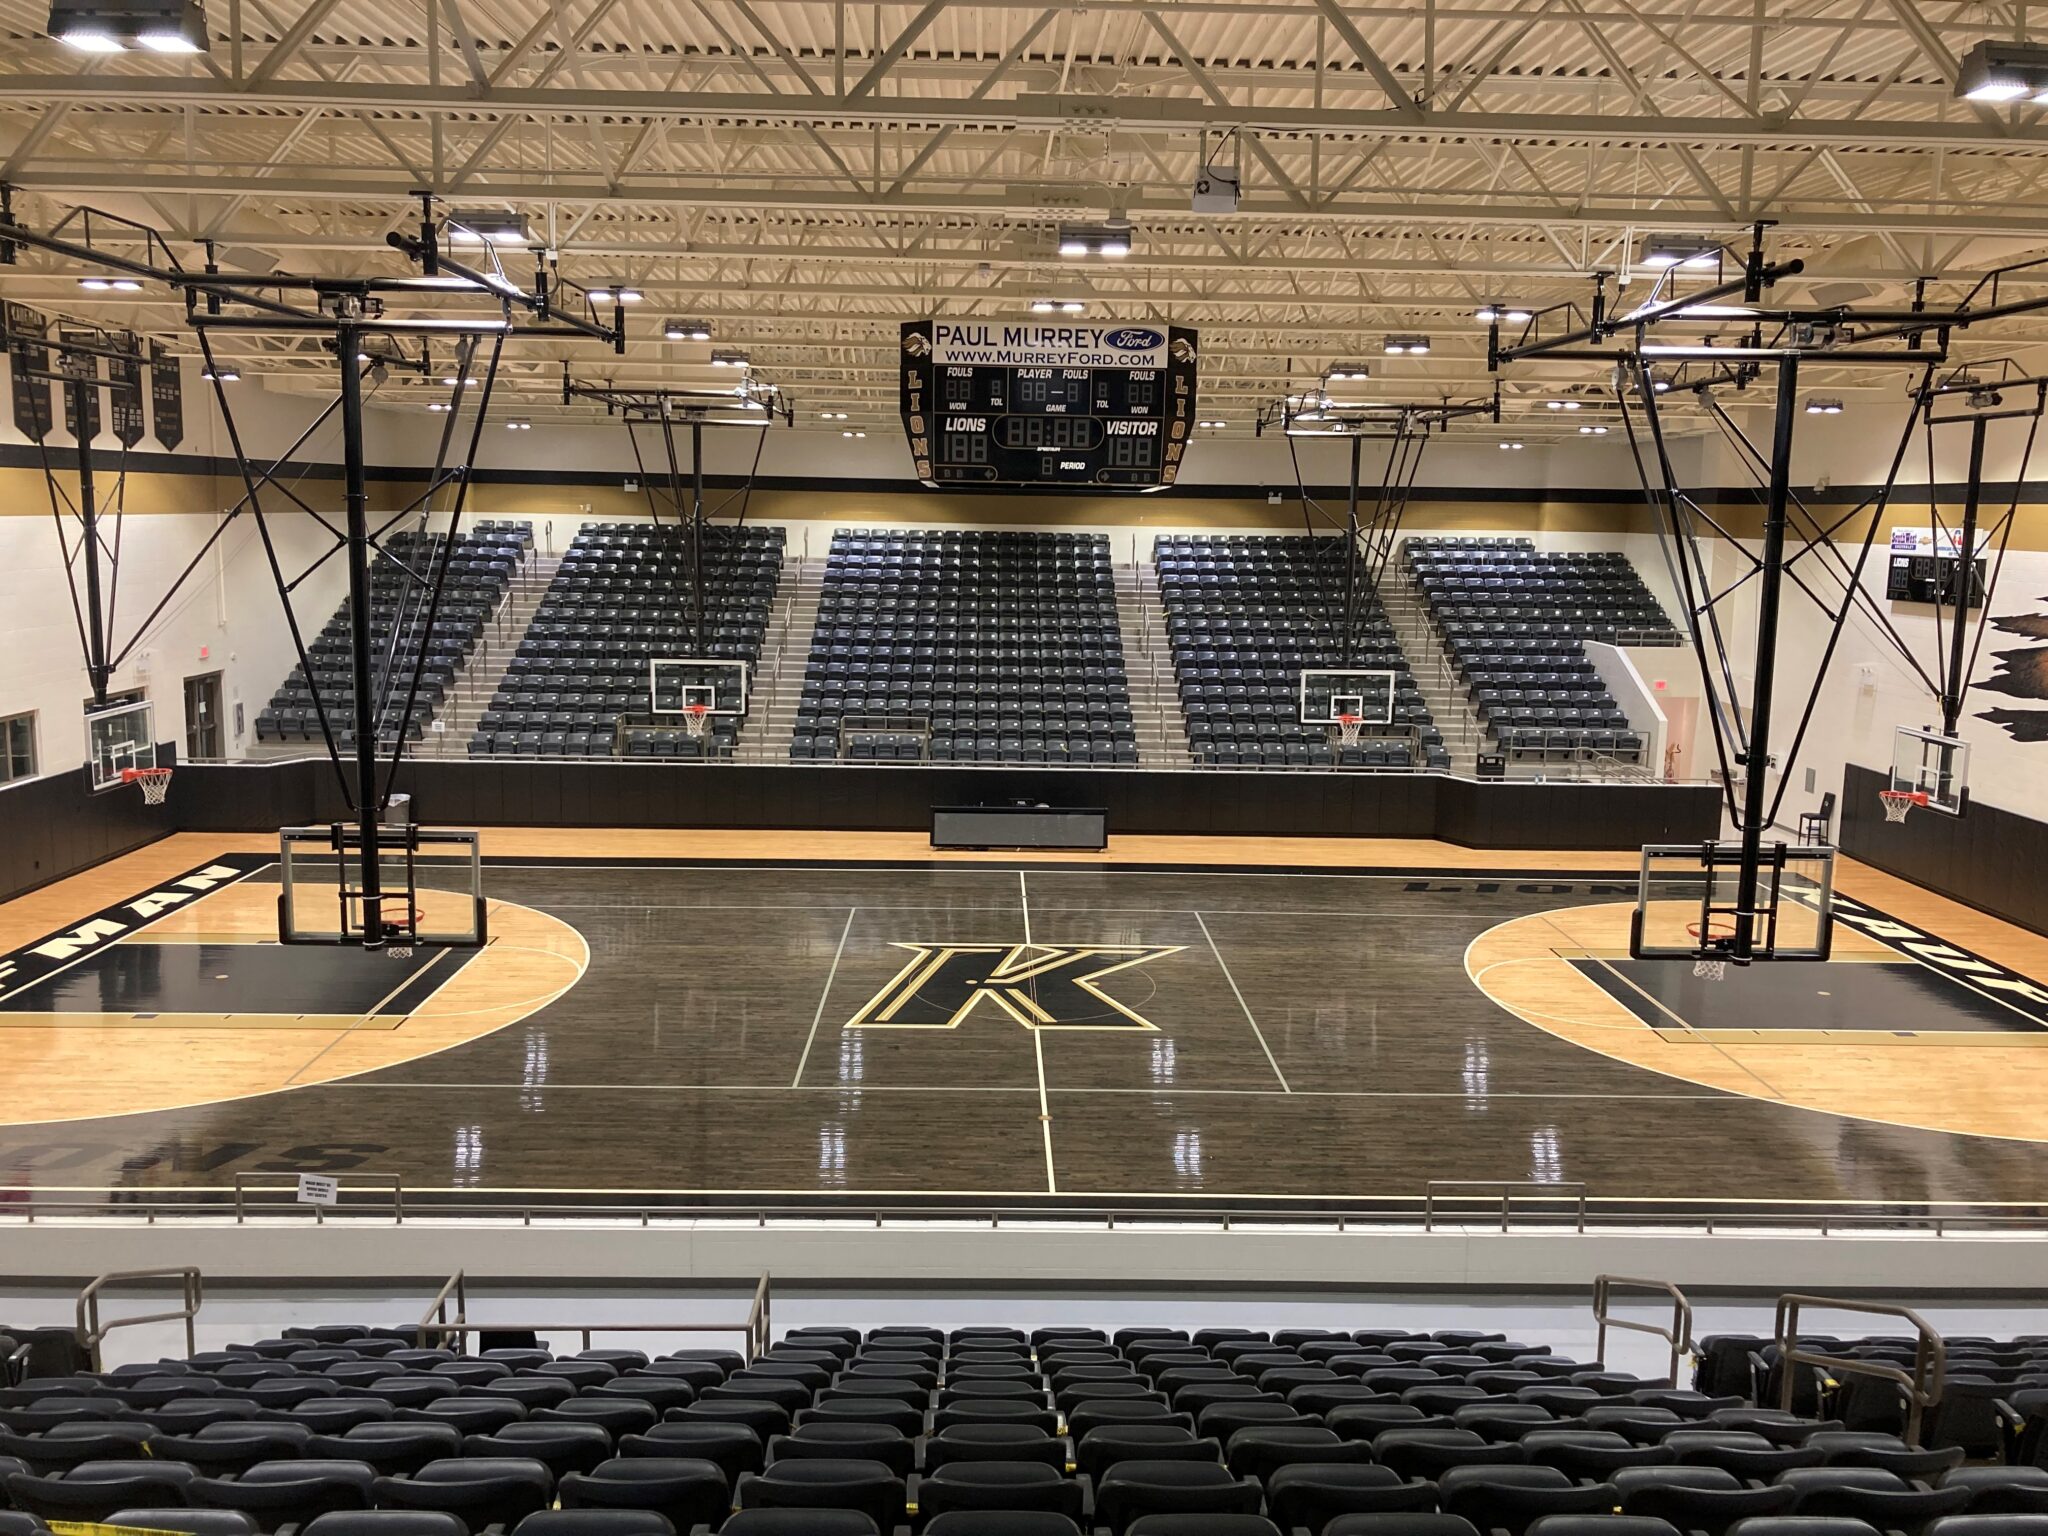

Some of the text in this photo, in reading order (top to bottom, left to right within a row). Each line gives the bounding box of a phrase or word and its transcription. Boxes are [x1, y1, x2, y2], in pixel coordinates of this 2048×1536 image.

[936, 325, 1152, 348] PAUL MURREY Ford
[947, 367, 973, 376] FOULS
[1018, 369, 1089, 379] PLAYER FOULS
[1129, 371, 1155, 380] FOULS
[949, 402, 967, 410] WON
[990, 398, 1003, 406] TOL
[1096, 400, 1109, 408] TOL
[1045, 404, 1067, 412] GAME
[1131, 406, 1149, 414] WON
[908, 370, 931, 478] LIONS
[945, 417, 987, 432] LIONS
[1106, 421, 1158, 436] VISITOR
[1162, 375, 1189, 483] LIONS
[1060, 462, 1085, 470] PERIOD
[843, 942, 1191, 1031] K
